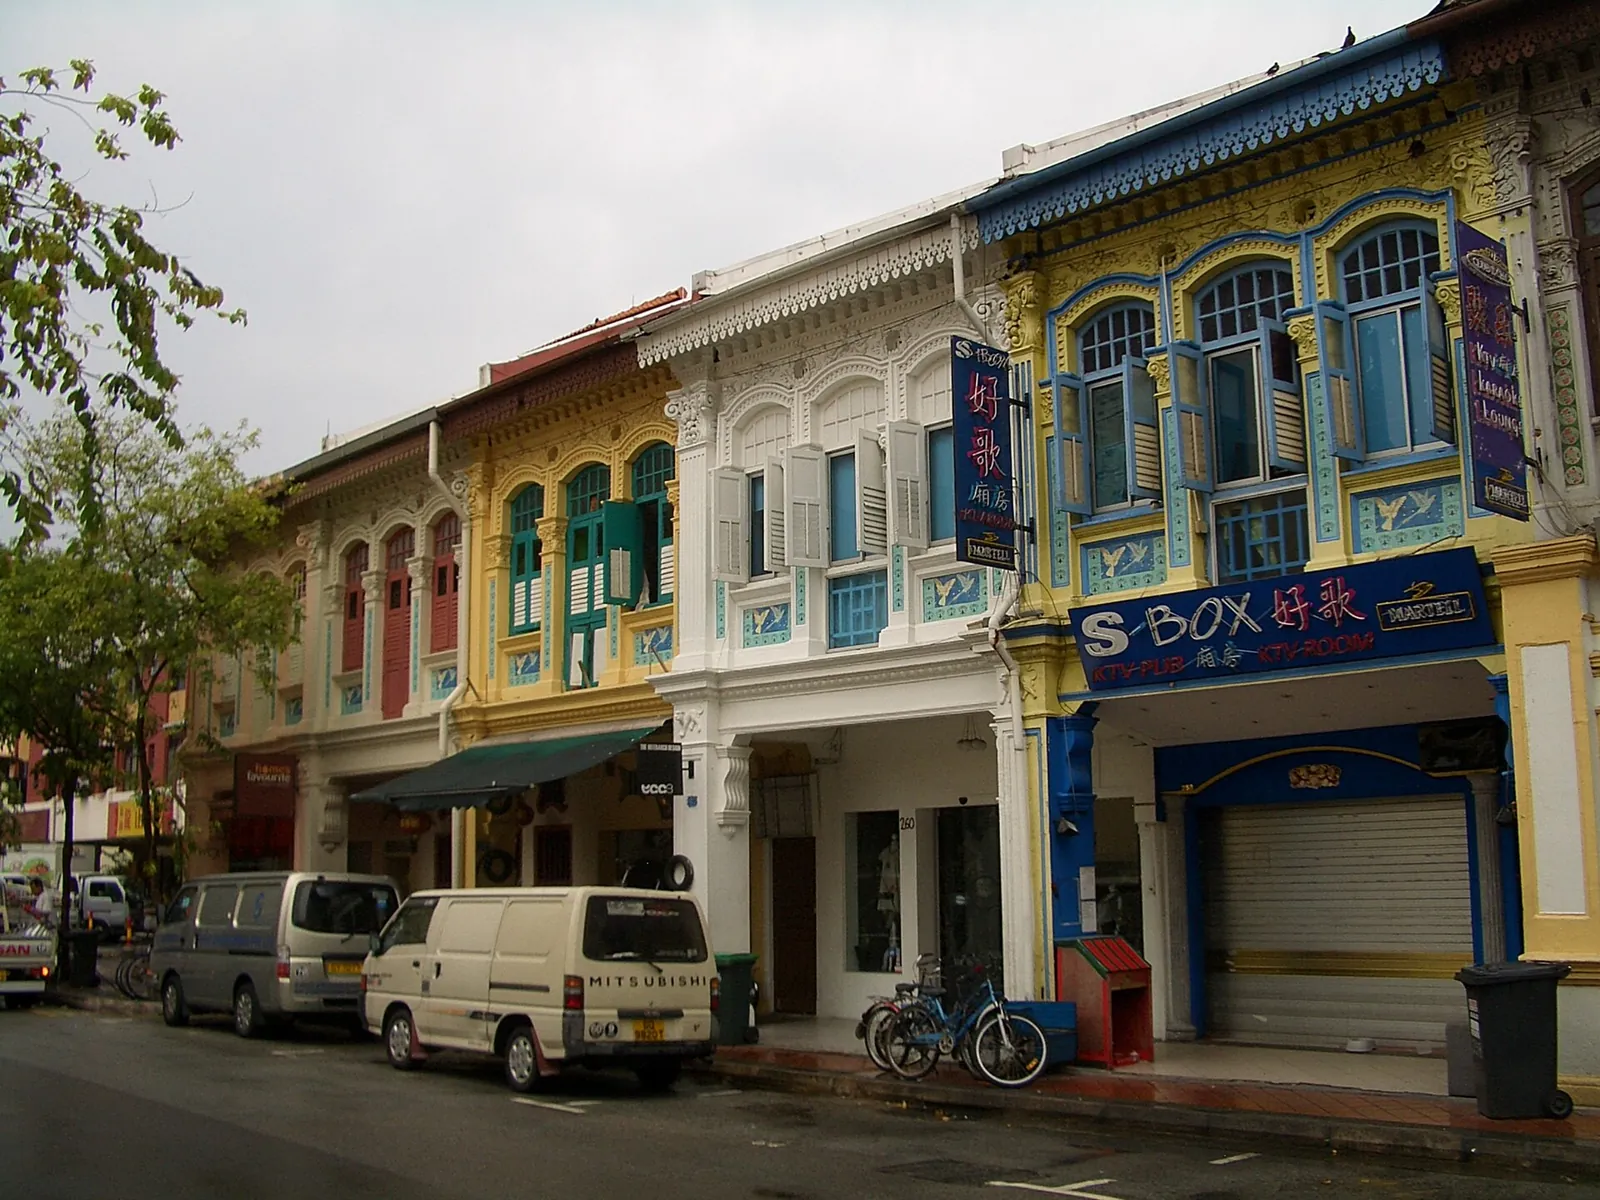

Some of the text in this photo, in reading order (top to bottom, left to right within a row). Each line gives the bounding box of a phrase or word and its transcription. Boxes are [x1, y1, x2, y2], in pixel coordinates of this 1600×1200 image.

[966, 371, 1006, 479] 好歌
[1081, 576, 1368, 657] S BOX 好歌
[1386, 599, 1466, 623] MARTELL
[1093, 662, 1135, 683] KTV
[1139, 655, 1184, 676] PUB
[1257, 642, 1300, 664] KTV
[1303, 631, 1375, 657] ROOM
[899, 817, 915, 831] 260
[589, 976, 707, 988] MITSUBISHI
